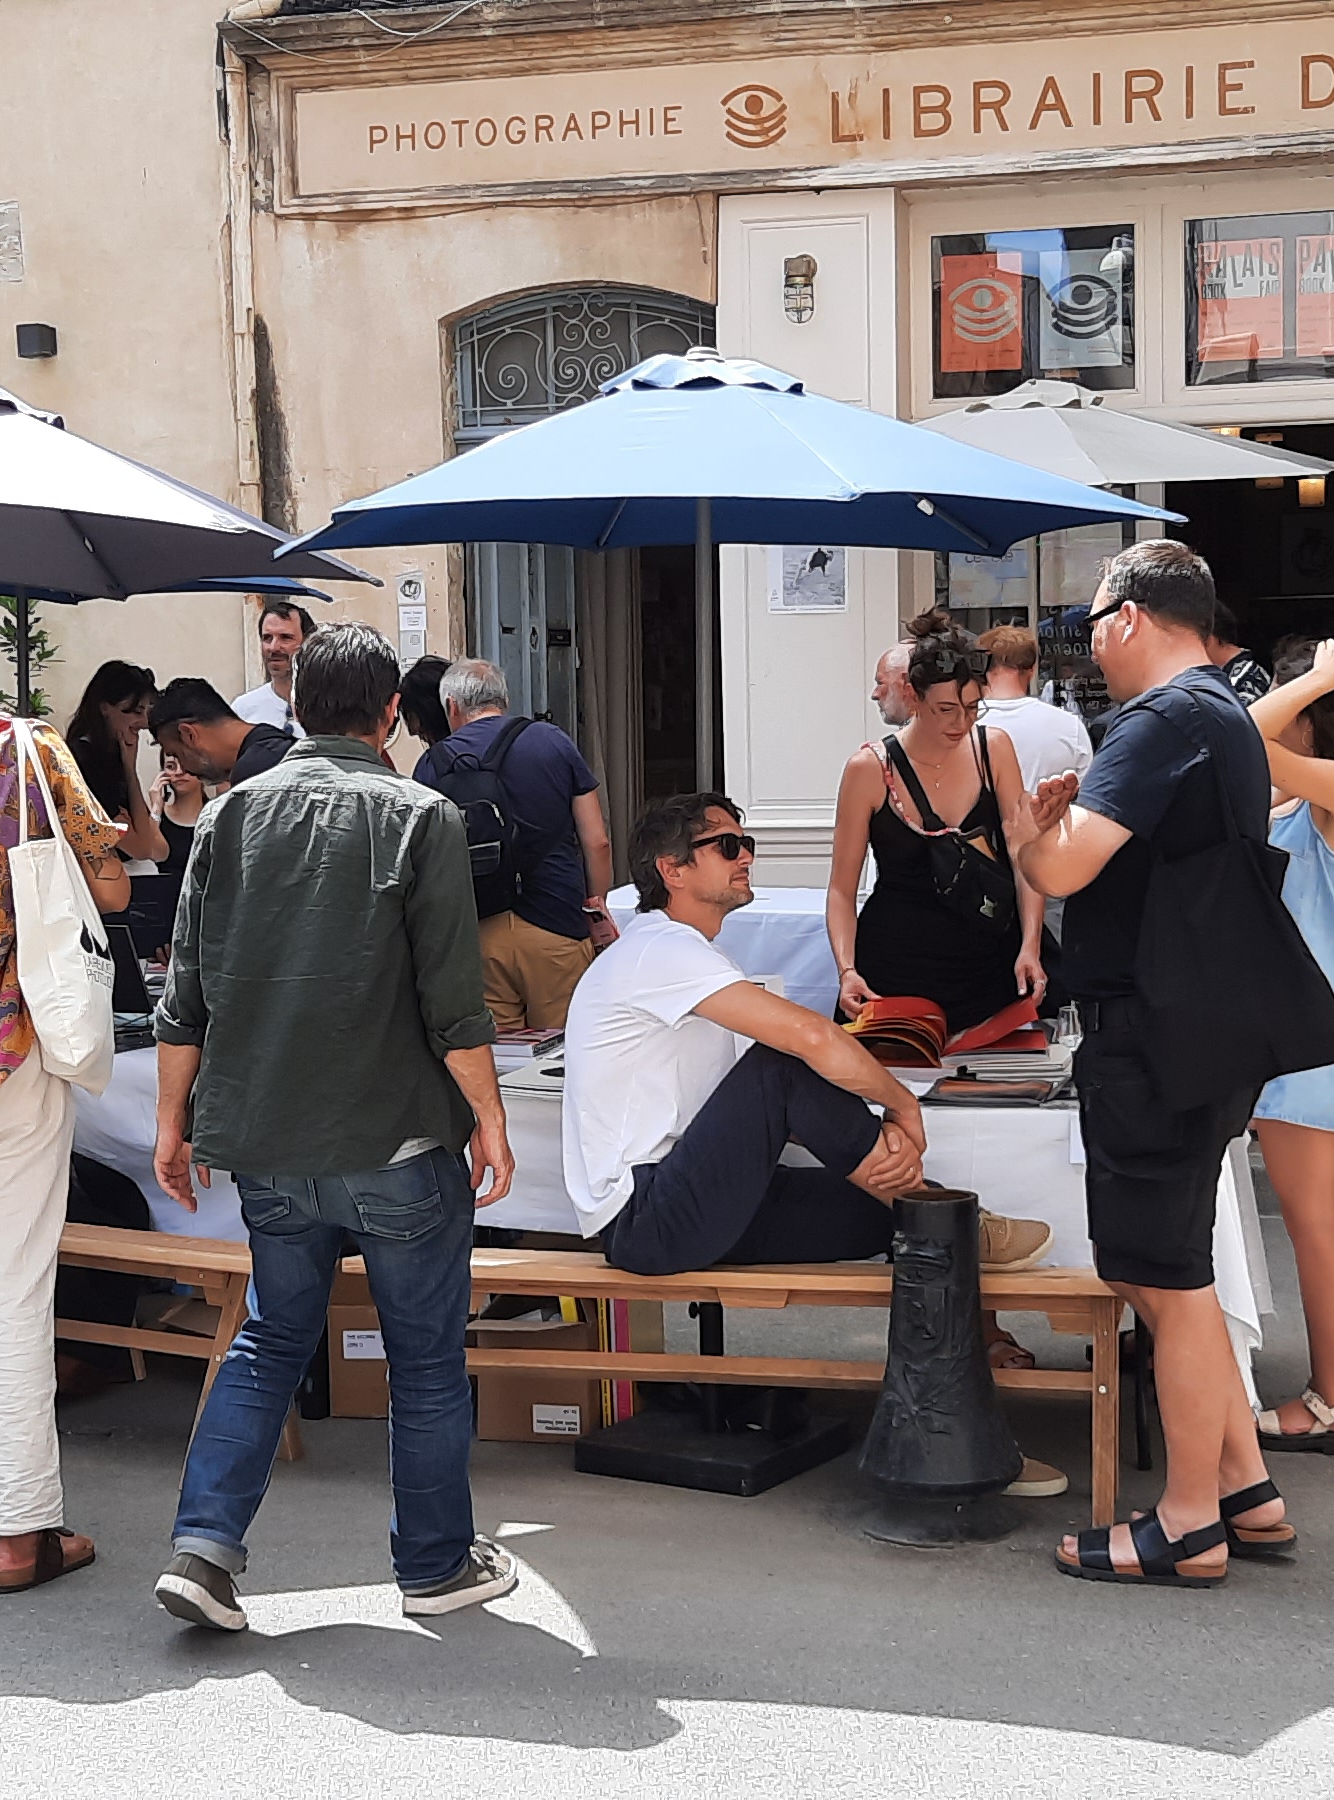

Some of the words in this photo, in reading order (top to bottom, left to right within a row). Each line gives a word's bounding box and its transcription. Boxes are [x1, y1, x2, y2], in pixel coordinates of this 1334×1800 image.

[368, 104, 683, 154] PHOTOGRAPHIE
[830, 59, 1256, 143] LIBRAIRIE
[1201, 241, 1280, 288] PALAIS
